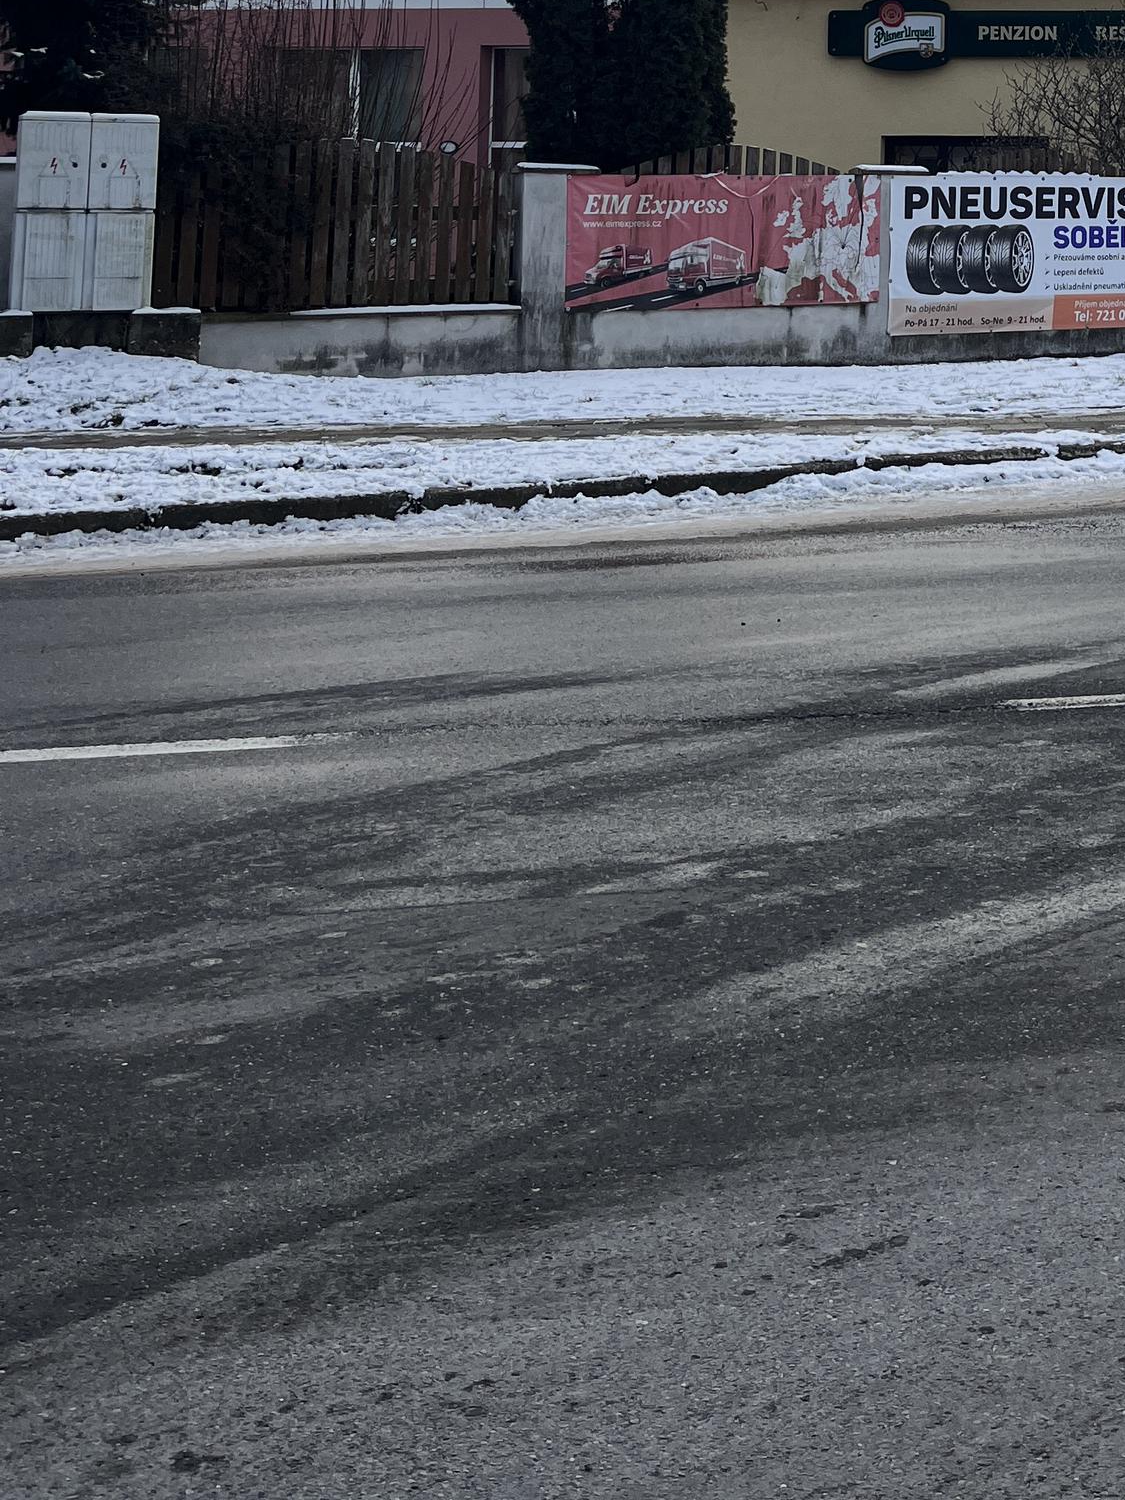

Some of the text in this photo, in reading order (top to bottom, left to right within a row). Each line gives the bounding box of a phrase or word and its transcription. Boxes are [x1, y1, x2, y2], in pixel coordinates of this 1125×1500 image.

[874, 25, 935, 48] Pilsner Urquell
[978, 26, 1058, 40] PENZION
[584, 194, 729, 220] EIM Express
[582, 220, 663, 229] www.eimexpress.cz
[1054, 253, 1096, 261] Přezouváme
[1096, 253, 1120, 261] osobní
[1054, 267, 1104, 277] Lepení defektů
[1054, 282, 1092, 290] Uskladnění
[905, 304, 958, 314] Na objednání
[1074, 300, 1098, 310] Příjem
[1074, 310, 1093, 322] Tel:
[1096, 310, 1116, 322] 721
[904, 318, 928, 328] Po-Pá
[929, 318, 939, 326] 17
[946, 318, 955, 326] 21
[957, 318, 974, 326] hod.
[980, 316, 1004, 325] So-Ne
[1007, 316, 1012, 324] 9
[1018, 316, 1027, 324] 21
[1029, 315, 1046, 324] hod.
